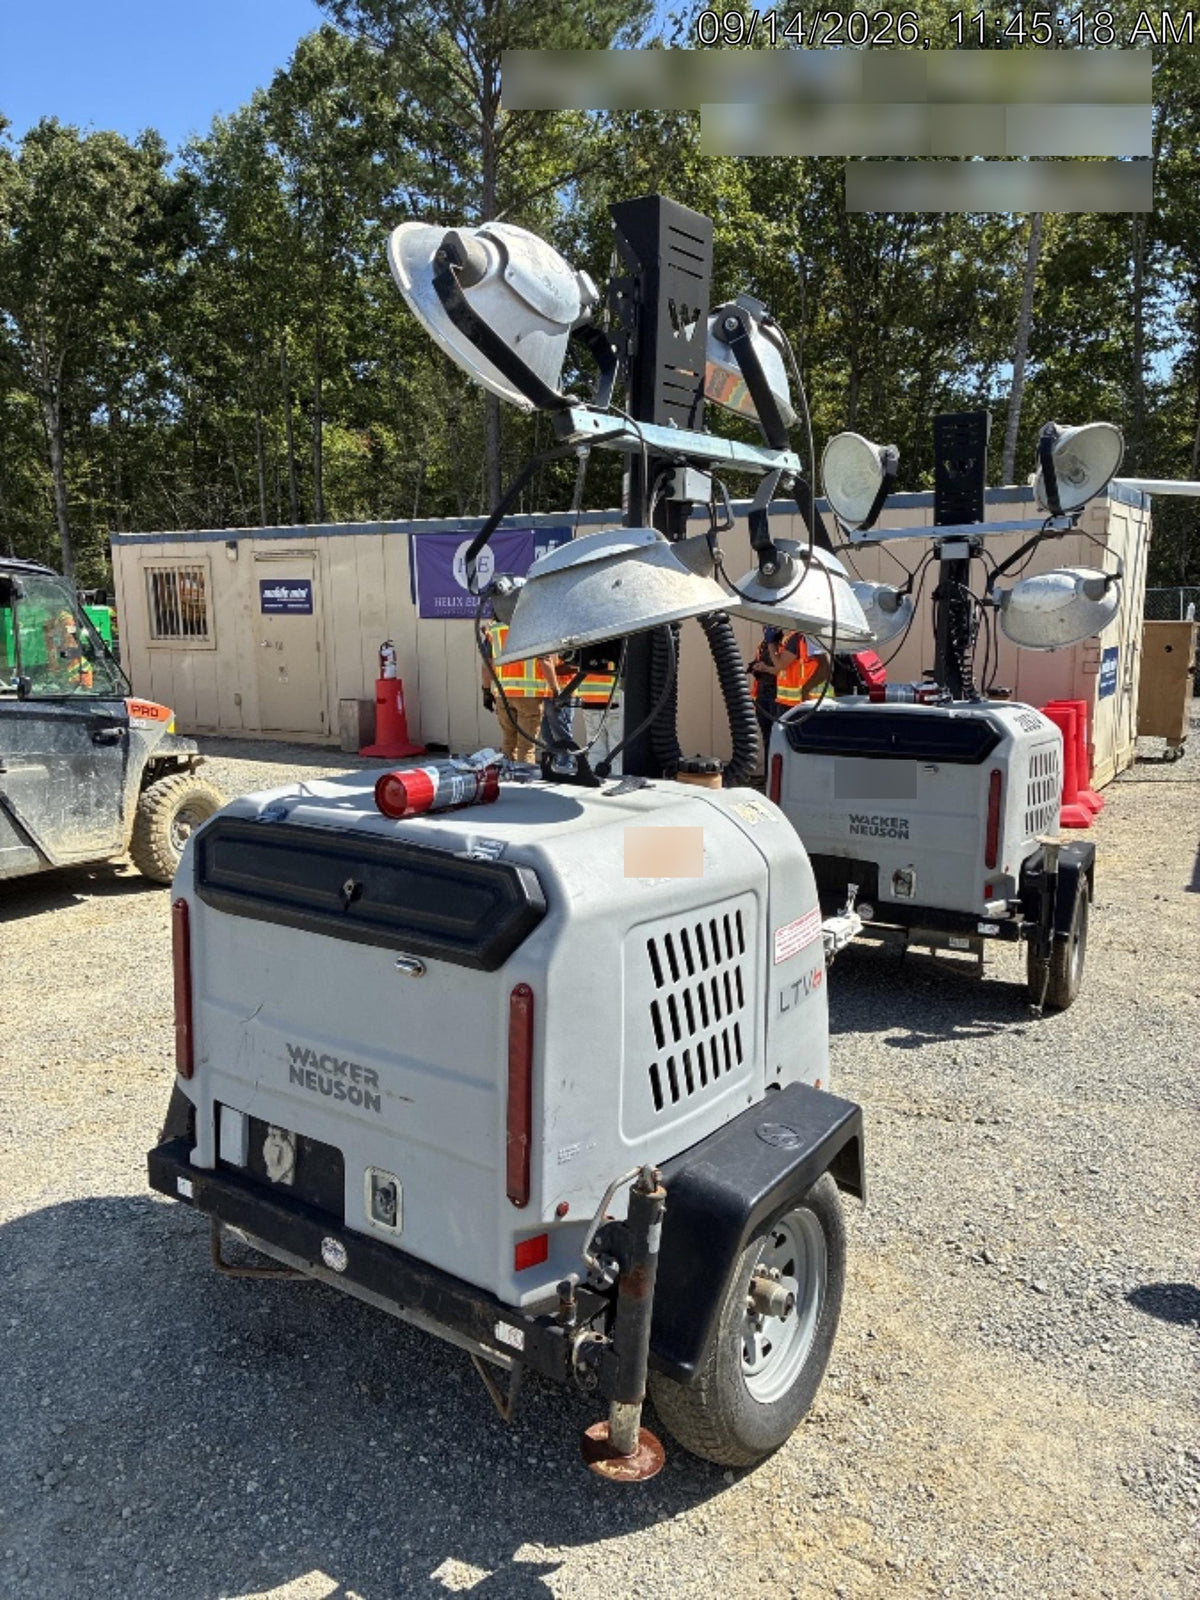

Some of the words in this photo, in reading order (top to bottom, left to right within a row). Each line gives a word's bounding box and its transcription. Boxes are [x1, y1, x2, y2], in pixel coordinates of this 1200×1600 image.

[434, 597, 463, 607] HELIX
[131, 703, 159, 718] PRO
[848, 814, 910, 829] WACKER
[850, 824, 910, 840] NEUSON
[286, 1043, 380, 1090] WACKER
[289, 1064, 382, 1113] NEUSON
